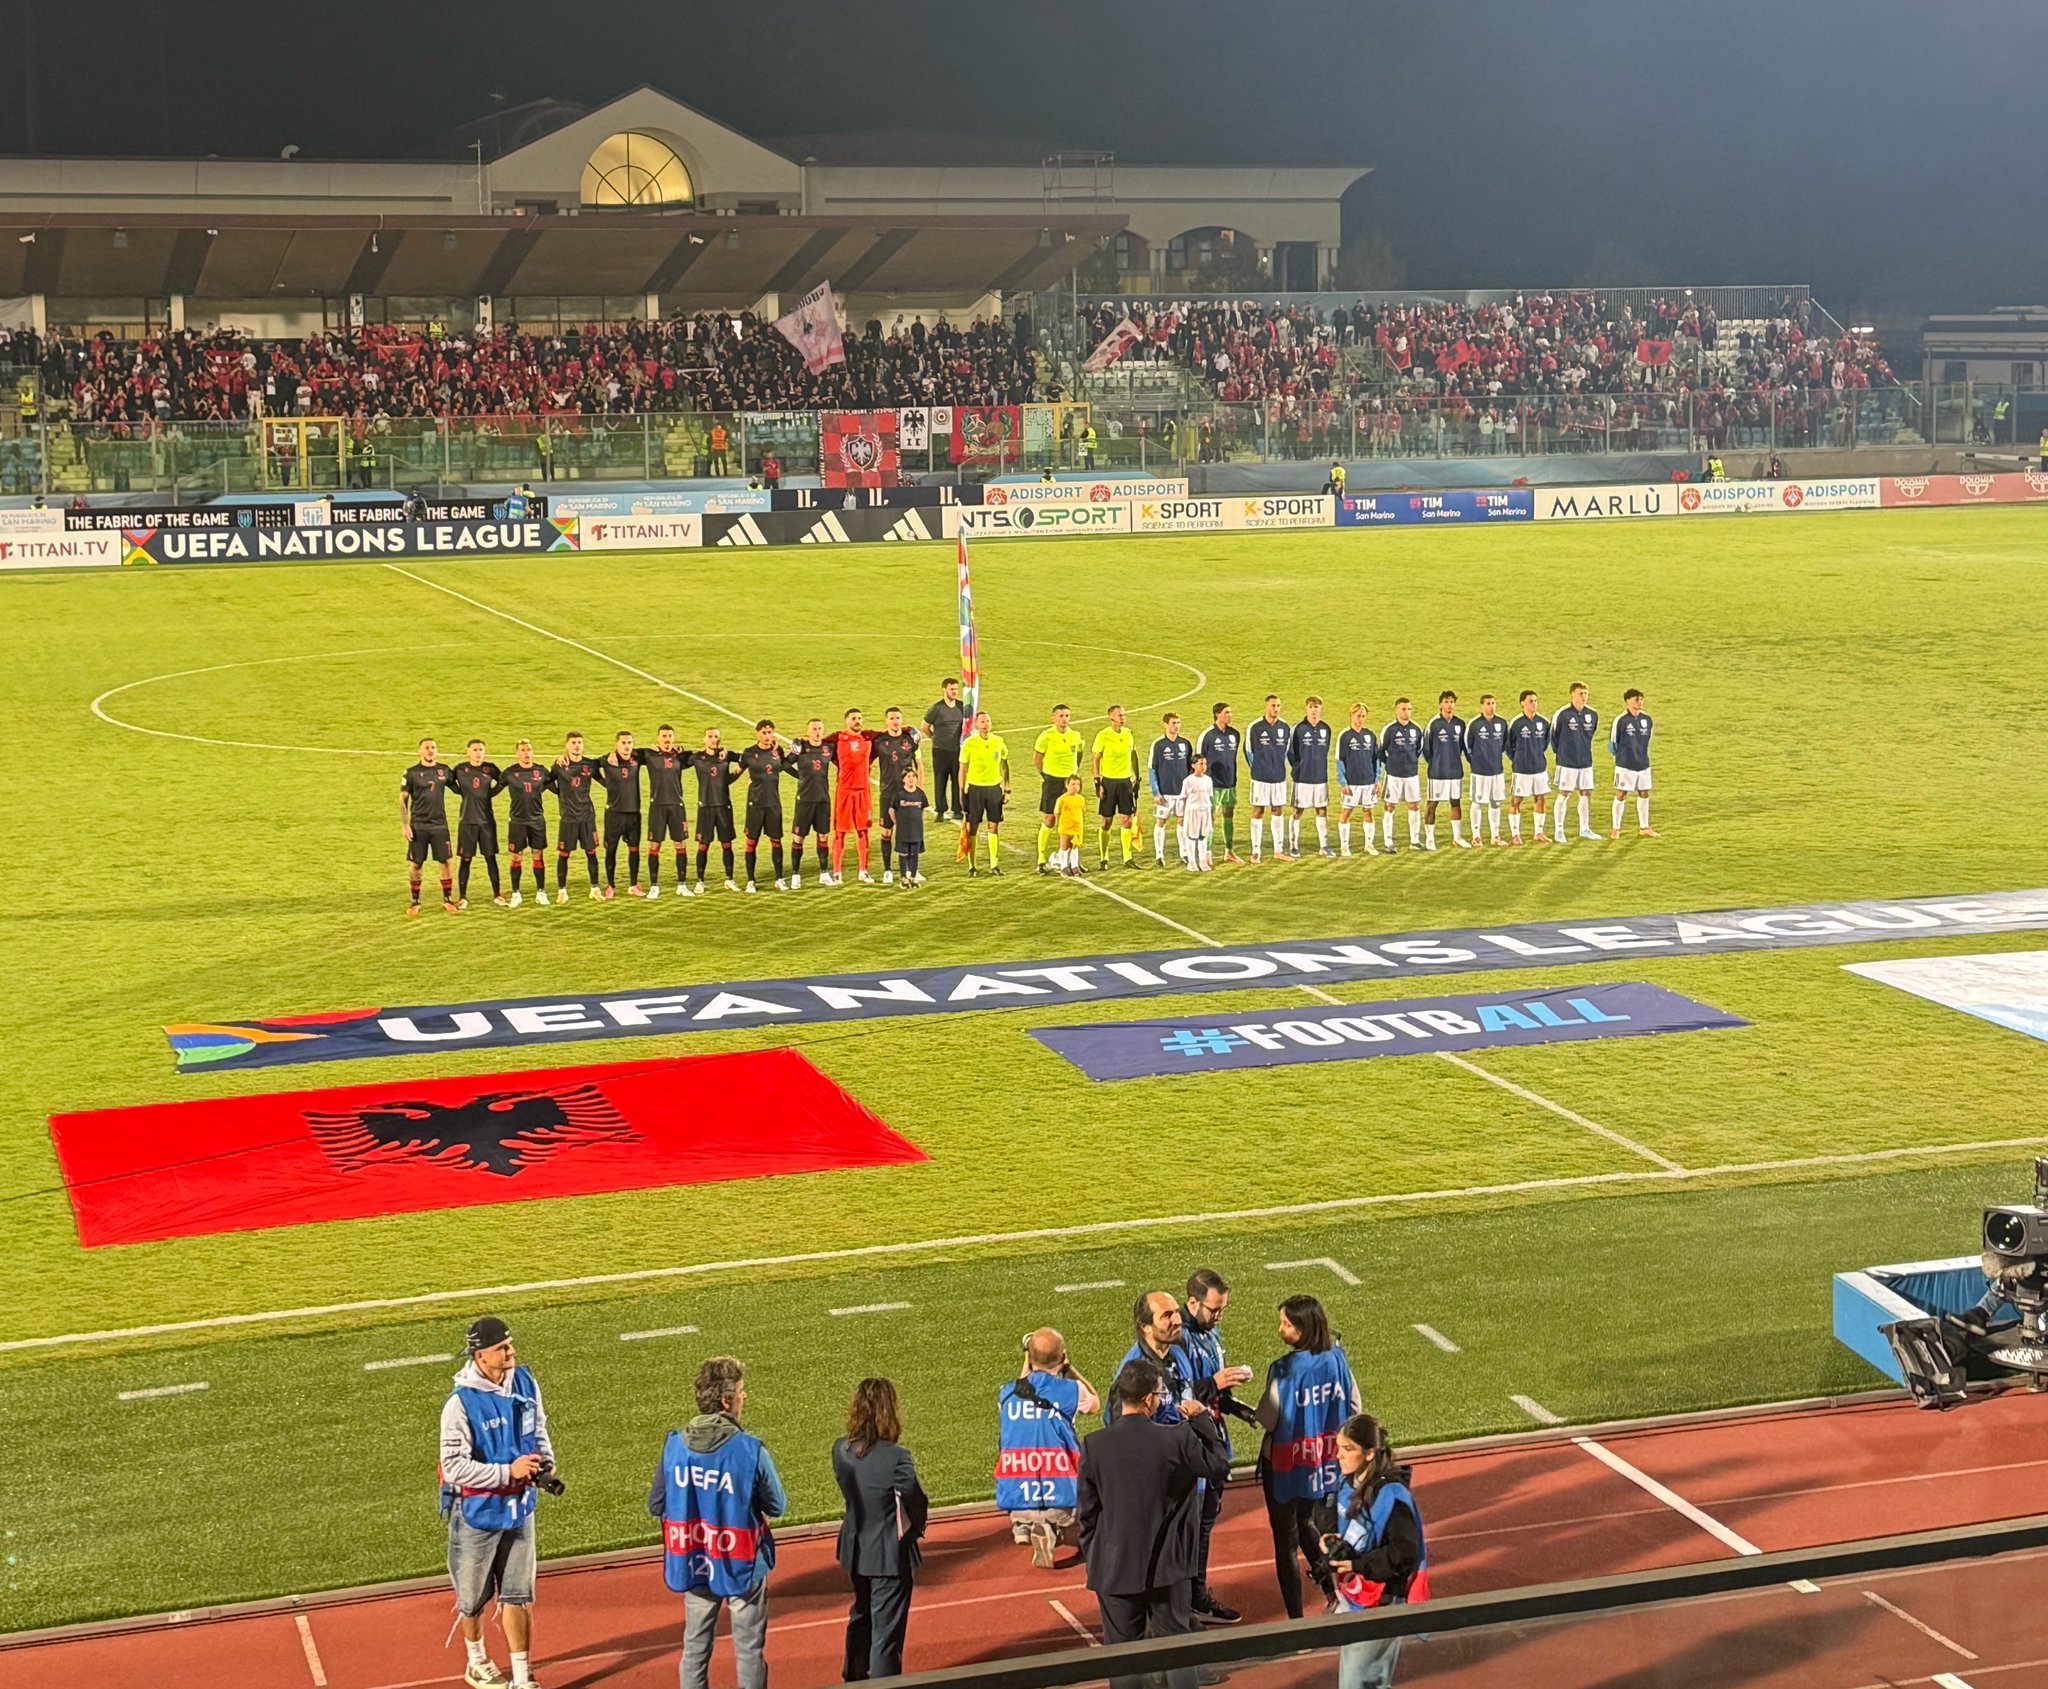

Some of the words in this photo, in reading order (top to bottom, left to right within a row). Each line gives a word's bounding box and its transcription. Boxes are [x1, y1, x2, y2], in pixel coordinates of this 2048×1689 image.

[1959, 475, 1995, 485] DOLOMIA
[1010, 486, 1082, 500] ADISPORT
[1113, 483, 1184, 497] ADISPORT
[1703, 486, 1775, 500] ADISPORT
[1805, 483, 1877, 497] ADISPORT
[661, 499, 691, 508] MARINO
[1245, 499, 1324, 517] K-SPORT
[1355, 499, 1376, 511] TIM
[1421, 497, 1442, 508] TIM
[1487, 495, 1508, 507] TIM
[1551, 487, 1660, 517] MARLÙ
[332, 509, 357, 522] THE
[360, 507, 403, 521] FABRIC
[426, 507, 448, 520] THE
[451, 505, 485, 519] GAME
[1035, 506, 1123, 527] SPORT
[1141, 502, 1222, 519] K-SPORT
[1355, 512, 1369, 520] San
[1370, 510, 1395, 519] Marino
[1422, 509, 1435, 518] San
[1437, 508, 1460, 517] Marino
[1488, 508, 1501, 517] San
[1502, 507, 1526, 515] Marino
[67, 516, 93, 530] THE
[96, 514, 142, 529] FABRIC
[146, 513, 162, 527] OF
[165, 513, 190, 527] THE
[192, 512, 229, 526] GAME
[1142, 521, 1174, 530] SCIENCE
[1176, 521, 1186, 529] TO
[1245, 519, 1276, 527] SCIENCE
[1279, 518, 1288, 526] TO
[610, 523, 691, 539] TITANI.TV
[163, 533, 249, 559] UEFA
[259, 527, 406, 556] NATIONS
[416, 523, 541, 551] LEAGUE
[17, 541, 108, 558] TITANI.TV
[892, 750, 898, 762] 6
[621, 767, 629, 778] 9
[710, 766, 718, 779] 3
[765, 763, 773, 774] 2
[427, 780, 435, 793] 7
[471, 776, 480, 789] 8
[523, 782, 532, 793] 11
[379, 991, 801, 1041] UEFA
[806, 939, 1477, 1005] NATIONS
[1478, 901, 2010, 956] LEAGUE
[1160, 997, 1631, 1056] #FOOTBALL
[1294, 1381, 1346, 1408] UEFA
[1292, 1434, 1337, 1464] PHOT
[1001, 1450, 1069, 1473] PHOTO
[674, 1465, 734, 1494] UEFA
[1019, 1480, 1056, 1502] 122
[669, 1522, 736, 1552] PHOTO
